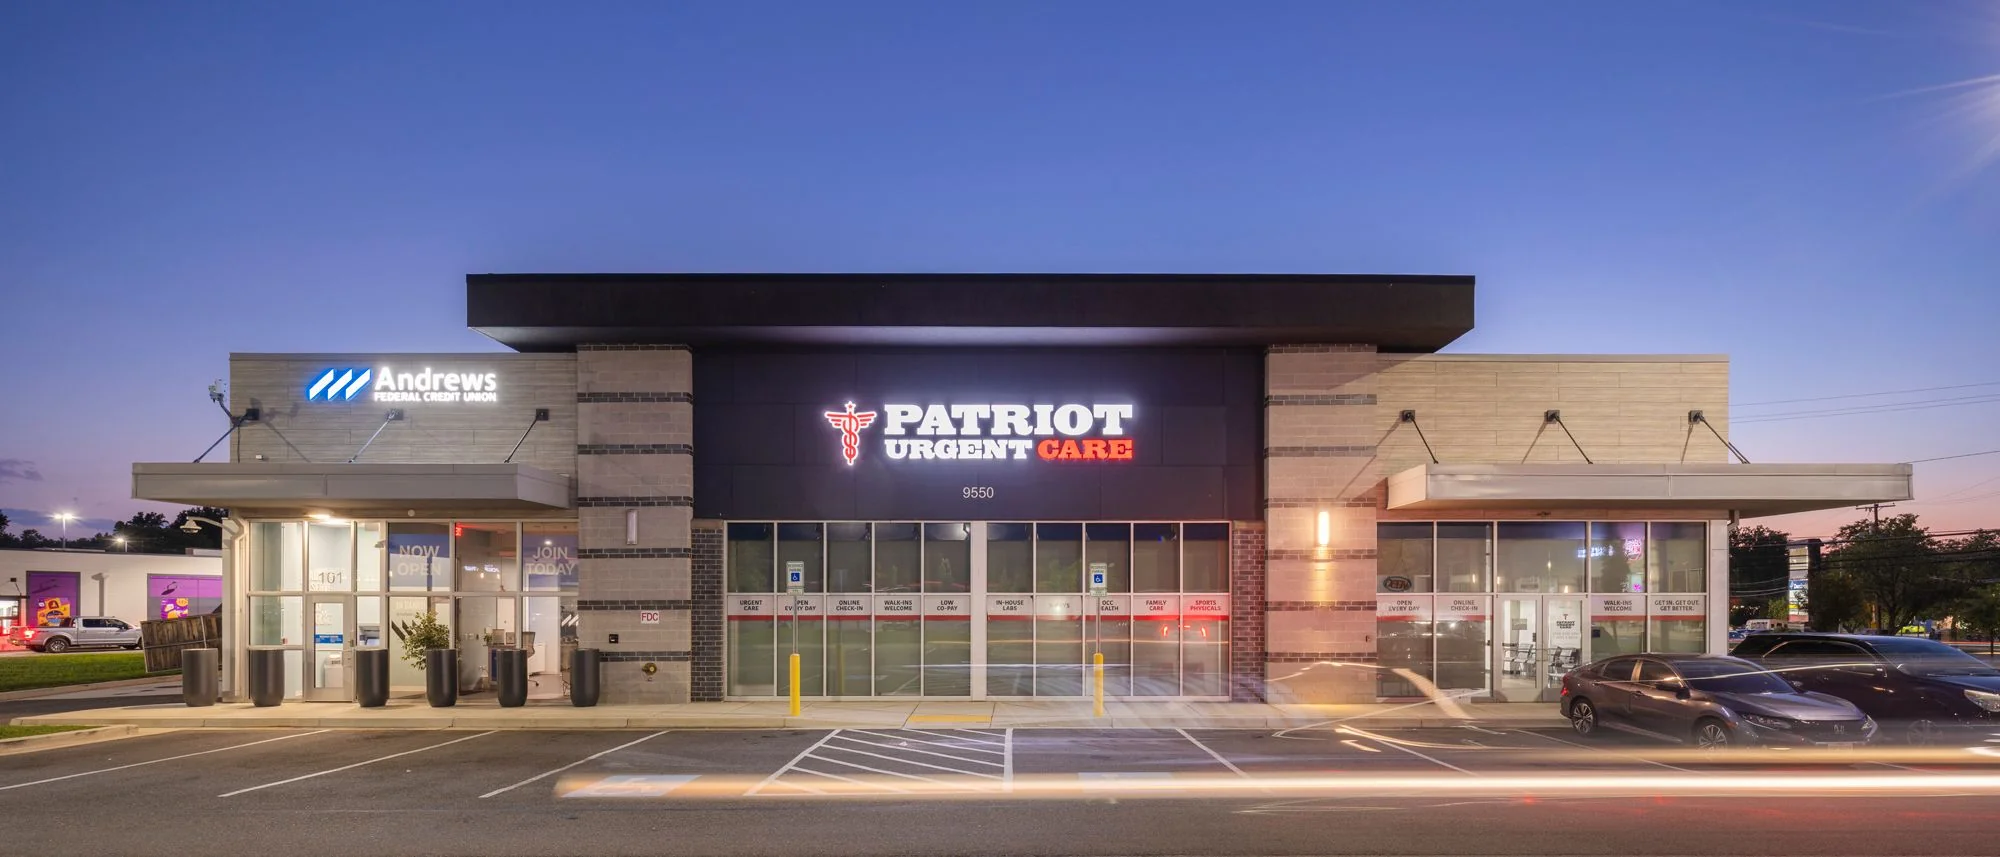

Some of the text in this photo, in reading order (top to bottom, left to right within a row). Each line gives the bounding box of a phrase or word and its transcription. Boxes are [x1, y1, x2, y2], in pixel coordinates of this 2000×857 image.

[374, 366, 497, 391] Andrews
[374, 391, 497, 401] FEDERAL CREDIT UNION
[884, 404, 1133, 436] PATRIOT
[884, 439, 1133, 460] URGENT CARE
[962, 486, 994, 499] 9550
[399, 545, 440, 558] NOW
[532, 546, 568, 559] JOIN
[397, 562, 441, 576] OPEN
[526, 563, 576, 576] TODAY
[318, 571, 343, 584] 101
[641, 612, 659, 622] FDC
